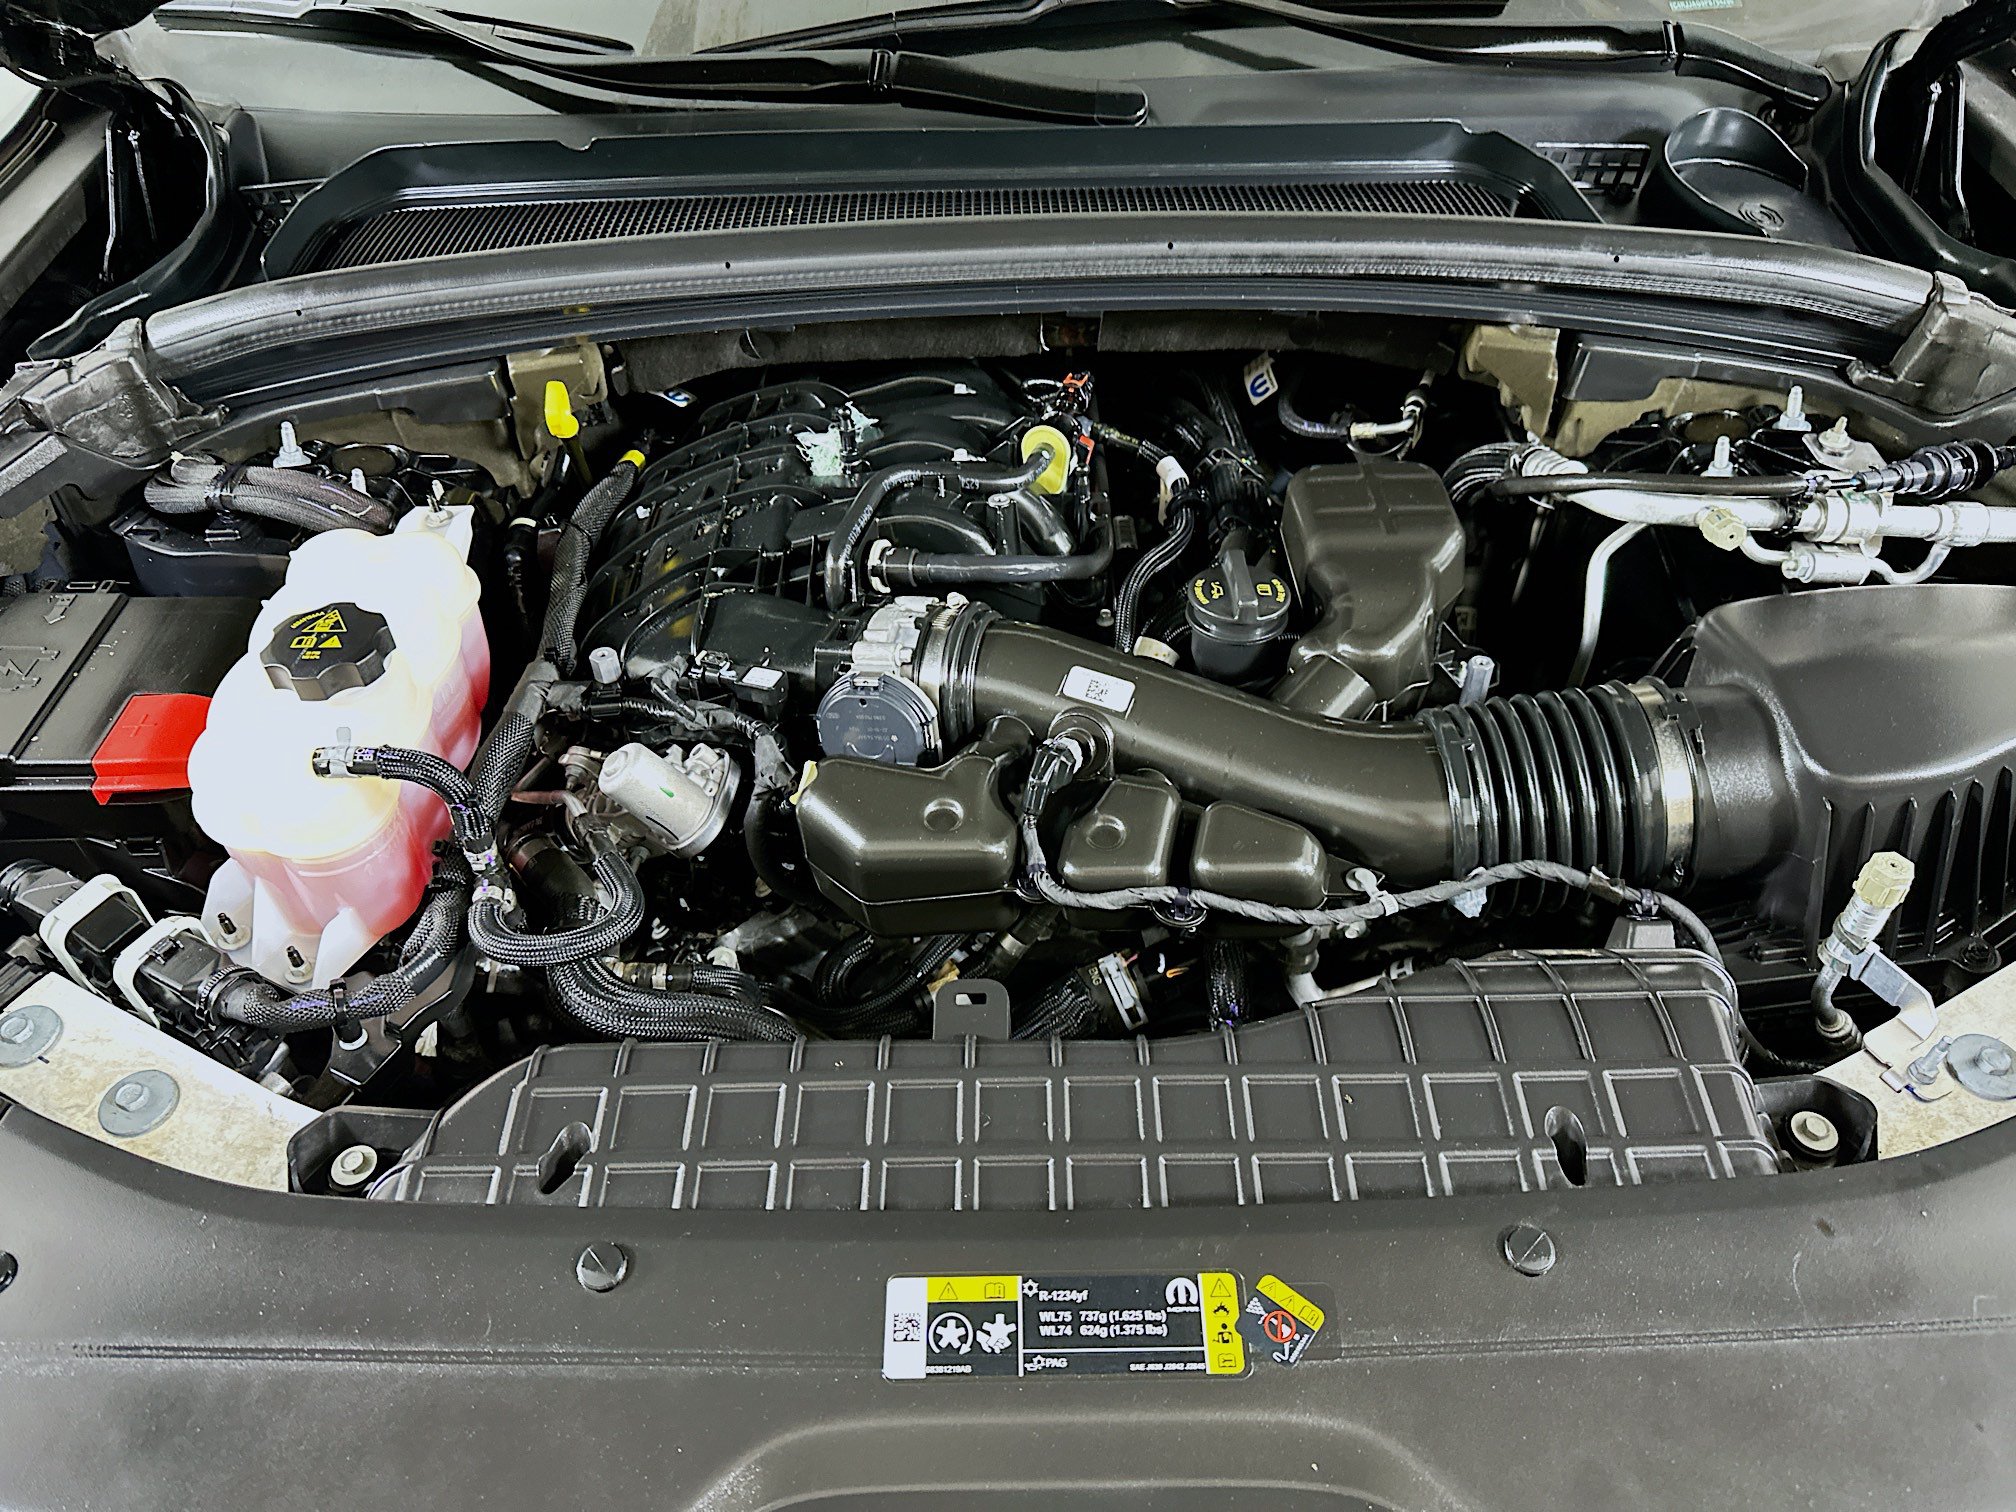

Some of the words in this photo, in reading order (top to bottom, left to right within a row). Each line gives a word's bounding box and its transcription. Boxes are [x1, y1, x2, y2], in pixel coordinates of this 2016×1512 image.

[1039, 1290, 1089, 1304] R-1234yf
[1039, 1311, 1073, 1323] WL75
[1079, 1310, 1108, 1324] 737g
[1145, 1310, 1168, 1323] lbs)
[1039, 1325, 1073, 1337] WL74
[1079, 1324, 1109, 1338] 624g
[1109, 1324, 1145, 1338] (1.375
[1145, 1323, 1169, 1337] lbs)
[1045, 1357, 1068, 1369] PAG
